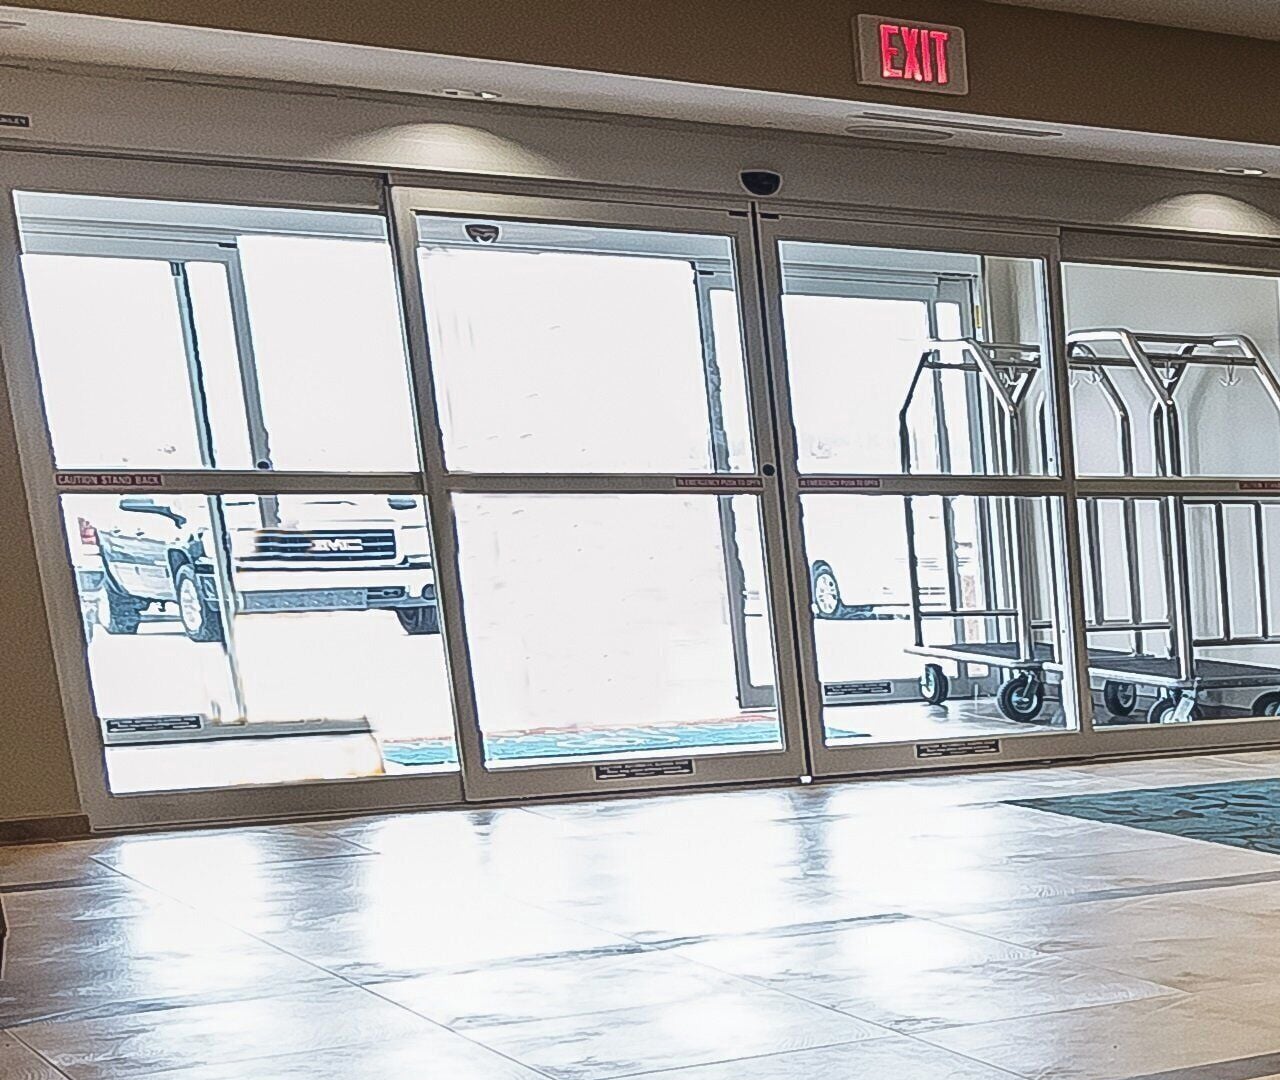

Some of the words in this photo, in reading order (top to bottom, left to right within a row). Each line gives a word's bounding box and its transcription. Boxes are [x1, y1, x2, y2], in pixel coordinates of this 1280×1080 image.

[880, 24, 948, 83] EXIT
[58, 475, 98, 485] CAUTION
[101, 475, 132, 485] STAND
[135, 476, 160, 485] BACK
